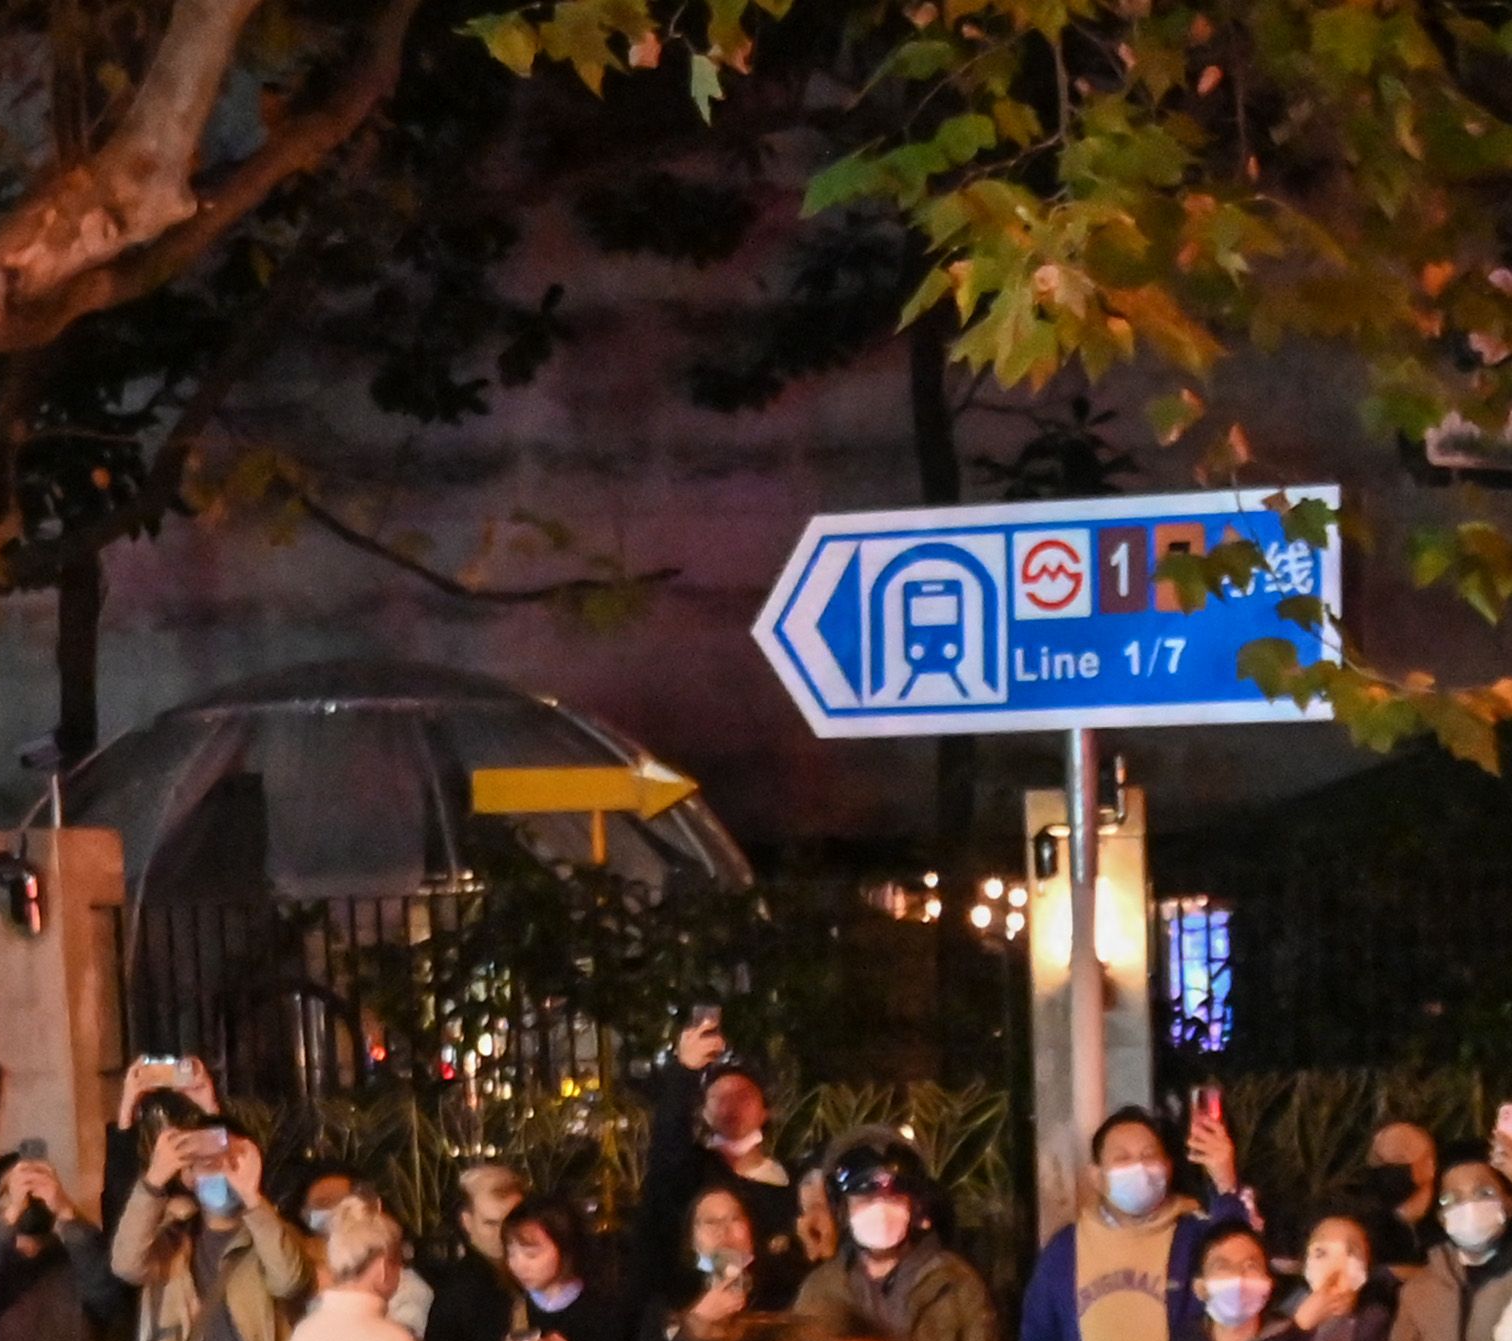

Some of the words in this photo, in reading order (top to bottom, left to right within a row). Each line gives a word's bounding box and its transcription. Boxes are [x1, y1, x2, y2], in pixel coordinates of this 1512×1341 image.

[1110, 543, 1129, 596] 1
[1015, 646, 1100, 681] Line
[1124, 637, 1186, 677] 1/7
